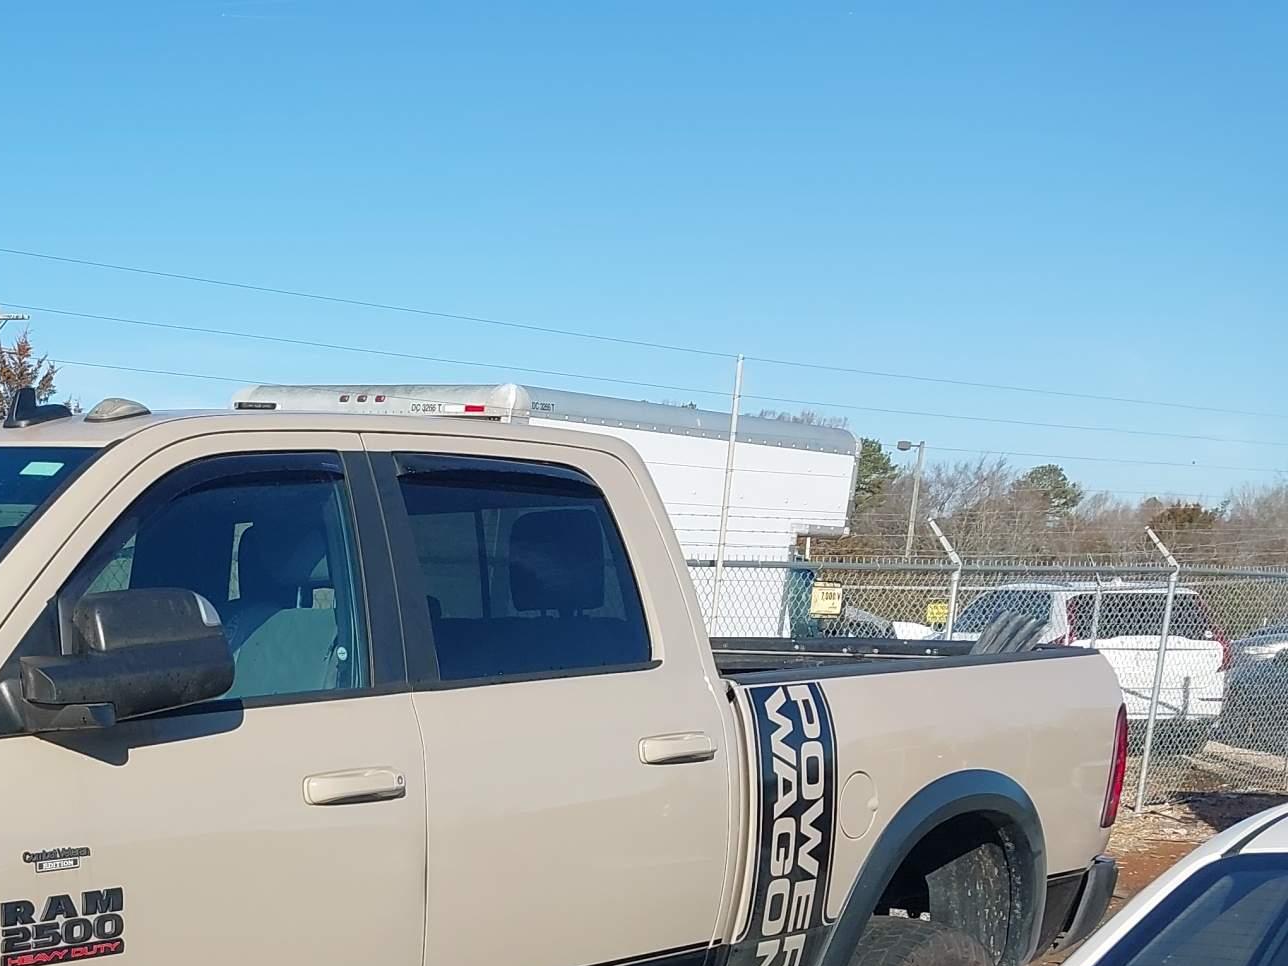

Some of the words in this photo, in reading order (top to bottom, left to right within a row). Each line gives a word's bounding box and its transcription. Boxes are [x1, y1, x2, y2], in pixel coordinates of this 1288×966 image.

[0, 887, 124, 927] RAM
[0, 914, 124, 953] 2500
[7, 949, 69, 966] HEAVY
[71, 941, 121, 958] DUTY
